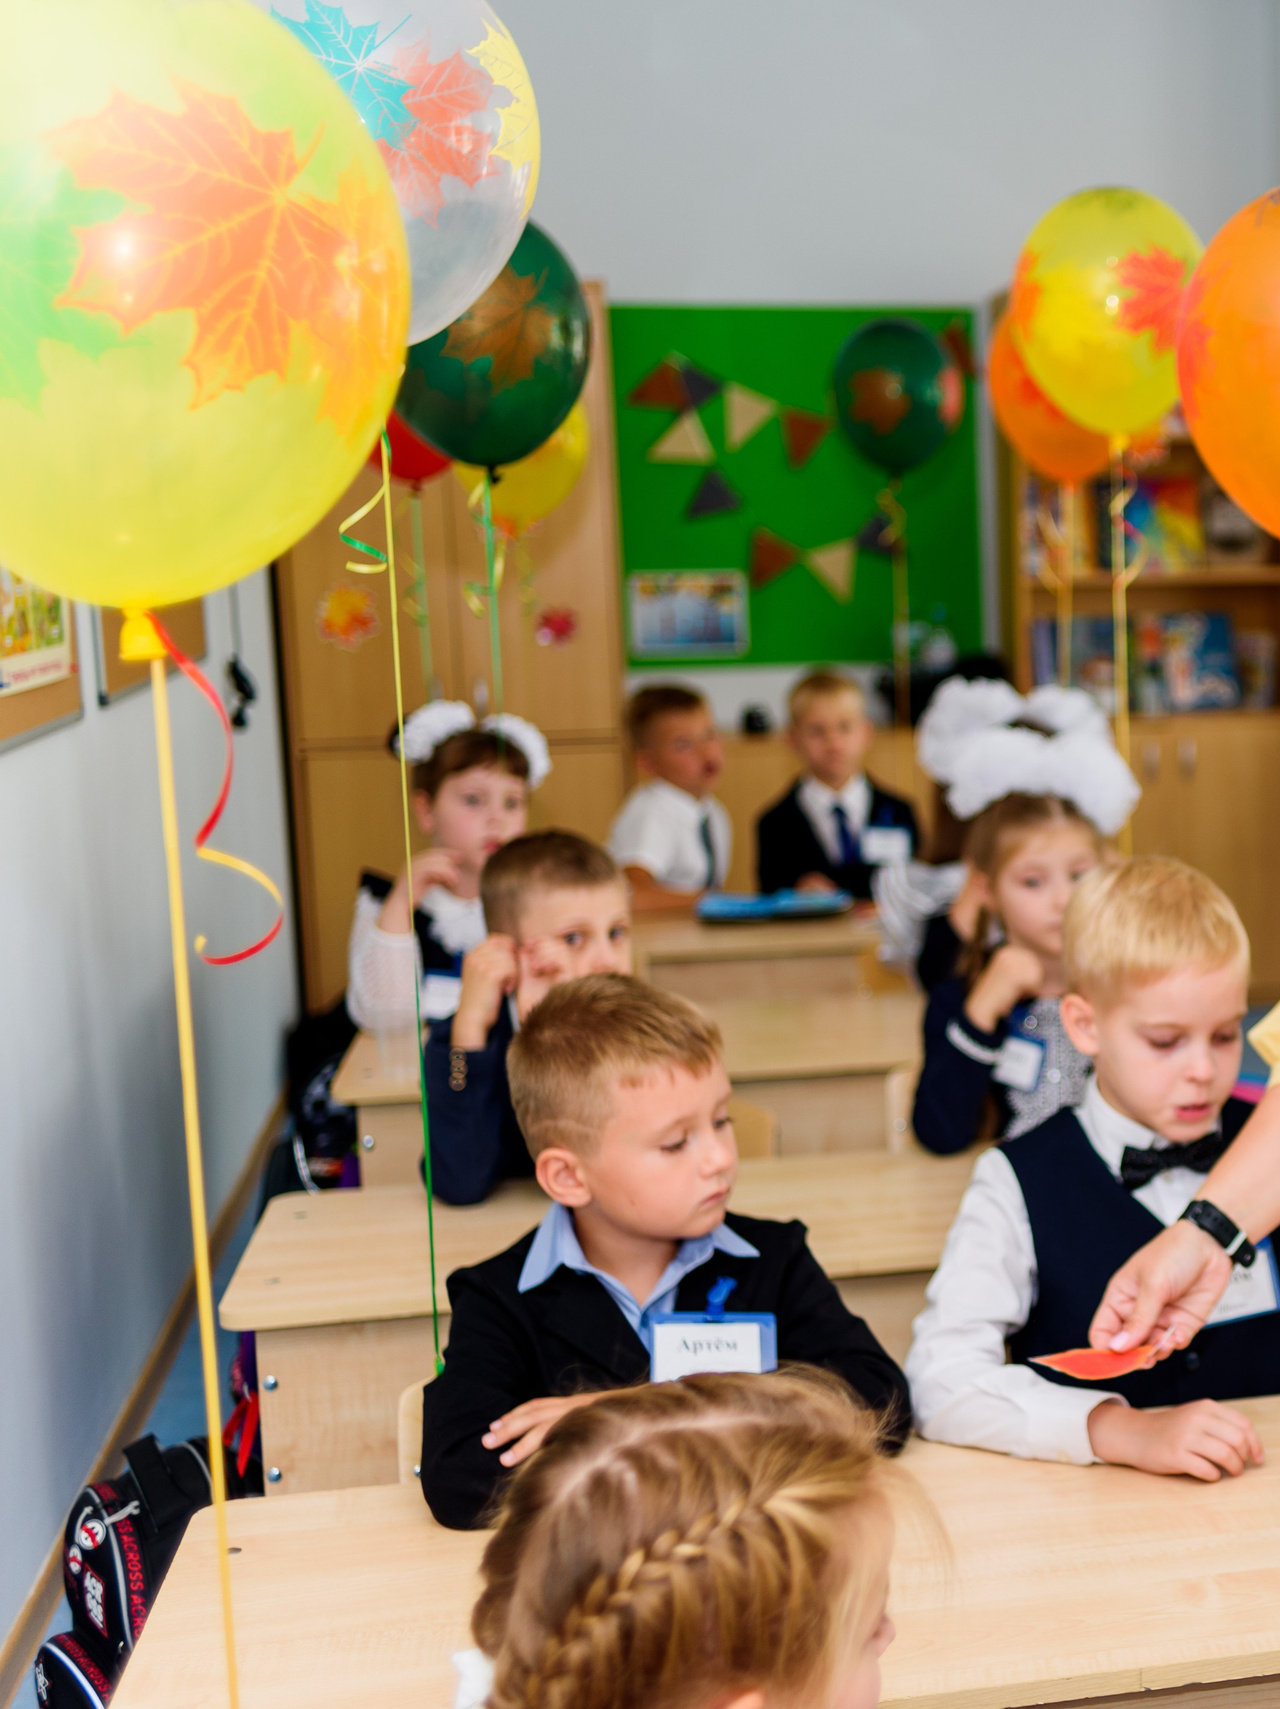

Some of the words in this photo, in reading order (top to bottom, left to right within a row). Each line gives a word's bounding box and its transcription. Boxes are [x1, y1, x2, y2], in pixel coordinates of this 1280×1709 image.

[678, 1336, 738, 1356] Артём
[122, 1536, 145, 1591] ACROSS
[130, 1594, 147, 1638] ACRO
